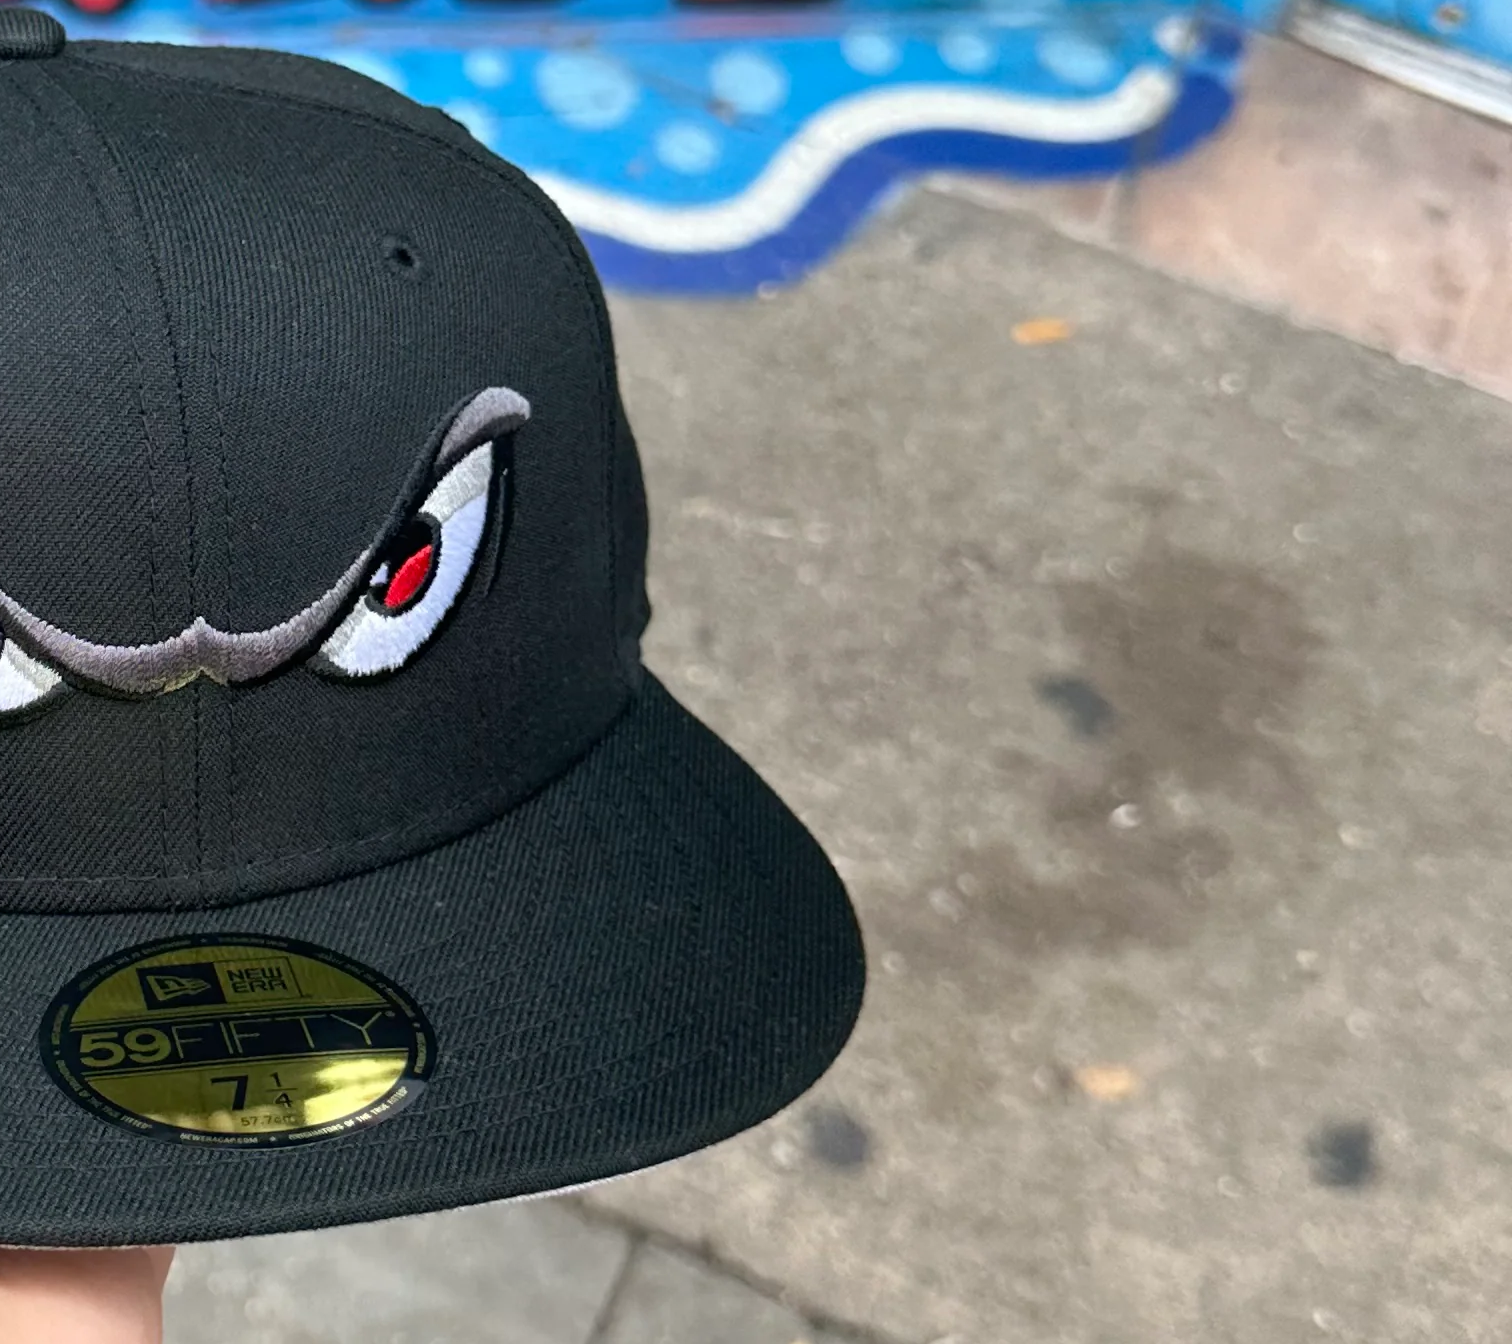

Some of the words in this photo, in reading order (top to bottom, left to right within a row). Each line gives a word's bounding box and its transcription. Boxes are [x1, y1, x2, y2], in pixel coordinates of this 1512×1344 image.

[227, 966, 283, 982] NEW
[231, 978, 288, 994] ERA
[79, 1010, 384, 1067] 59FIFTY
[210, 1074, 248, 1111] 7
